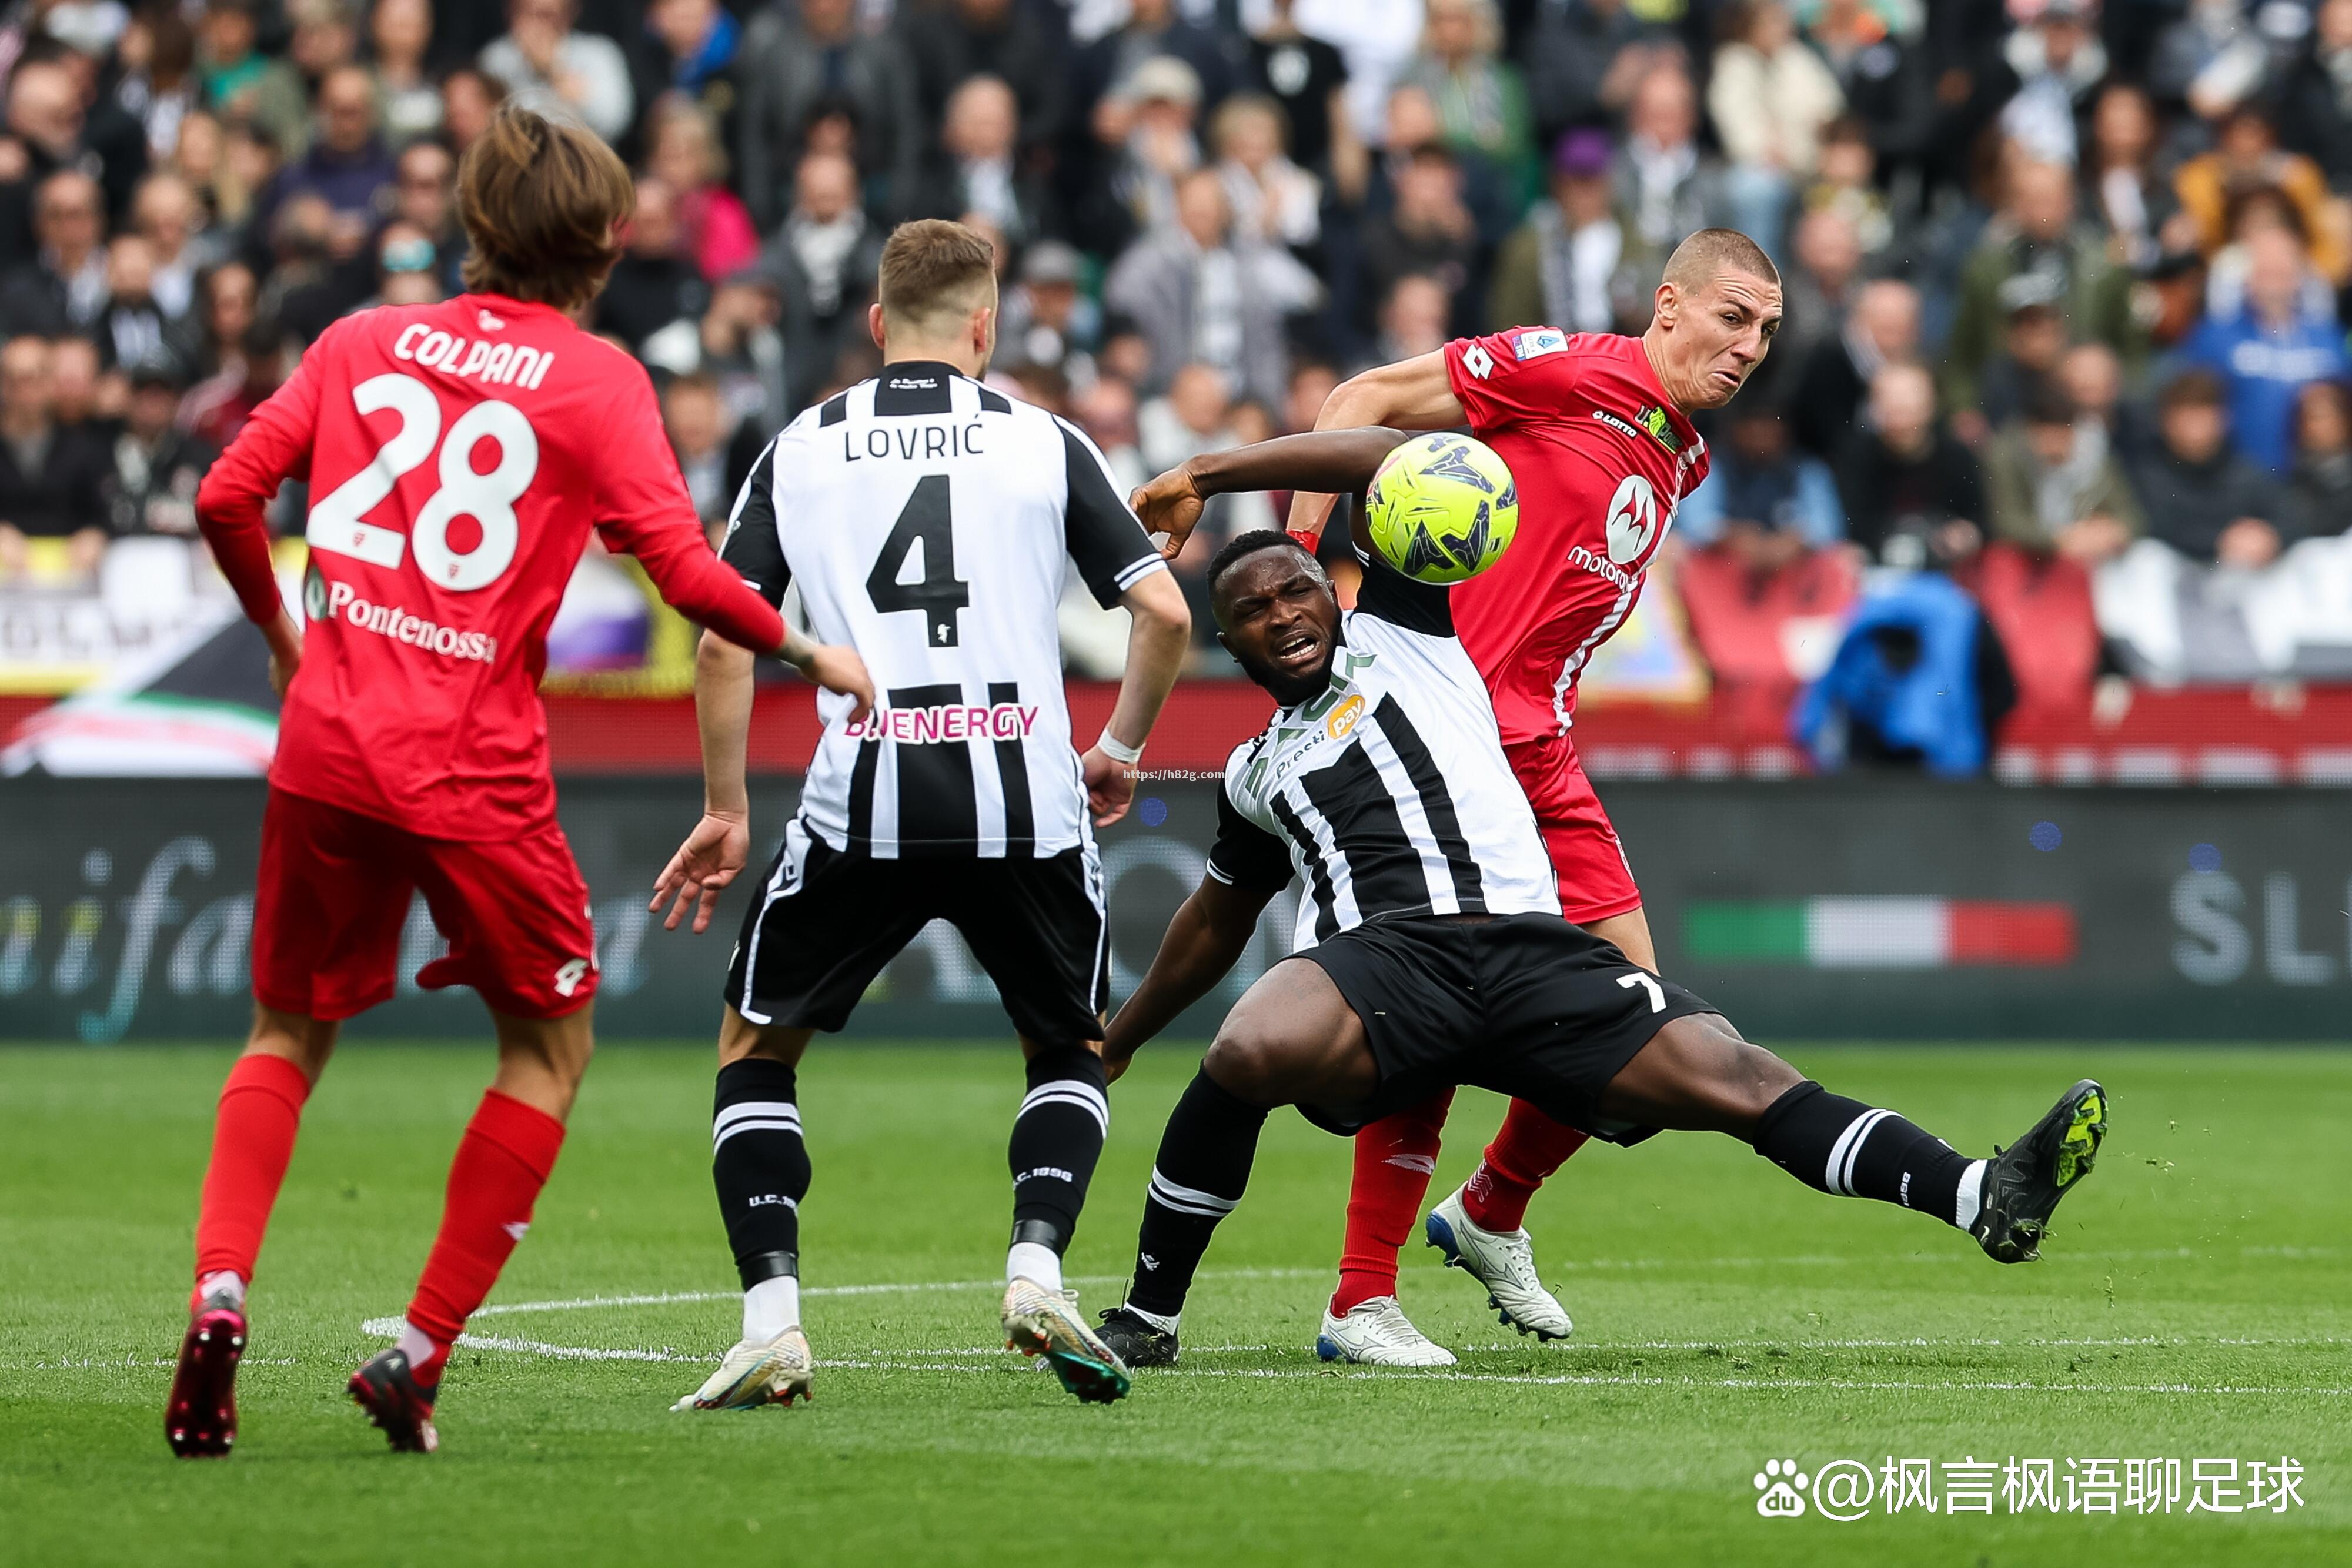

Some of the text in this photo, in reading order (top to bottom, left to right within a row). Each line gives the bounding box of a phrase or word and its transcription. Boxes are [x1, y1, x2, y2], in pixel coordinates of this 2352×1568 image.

[393, 323, 555, 390] COLPANI
[845, 413, 984, 462] LOVRIĆ
[1602, 414, 1638, 437] LOTTO
[306, 372, 539, 591] 28
[866, 474, 969, 647] 4
[1566, 546, 1633, 593] motoro
[844, 706, 1039, 741] BENERGY
[1332, 699, 1362, 737] pay
[2170, 869, 2352, 987] SL
[1616, 971, 1666, 1014] 7
